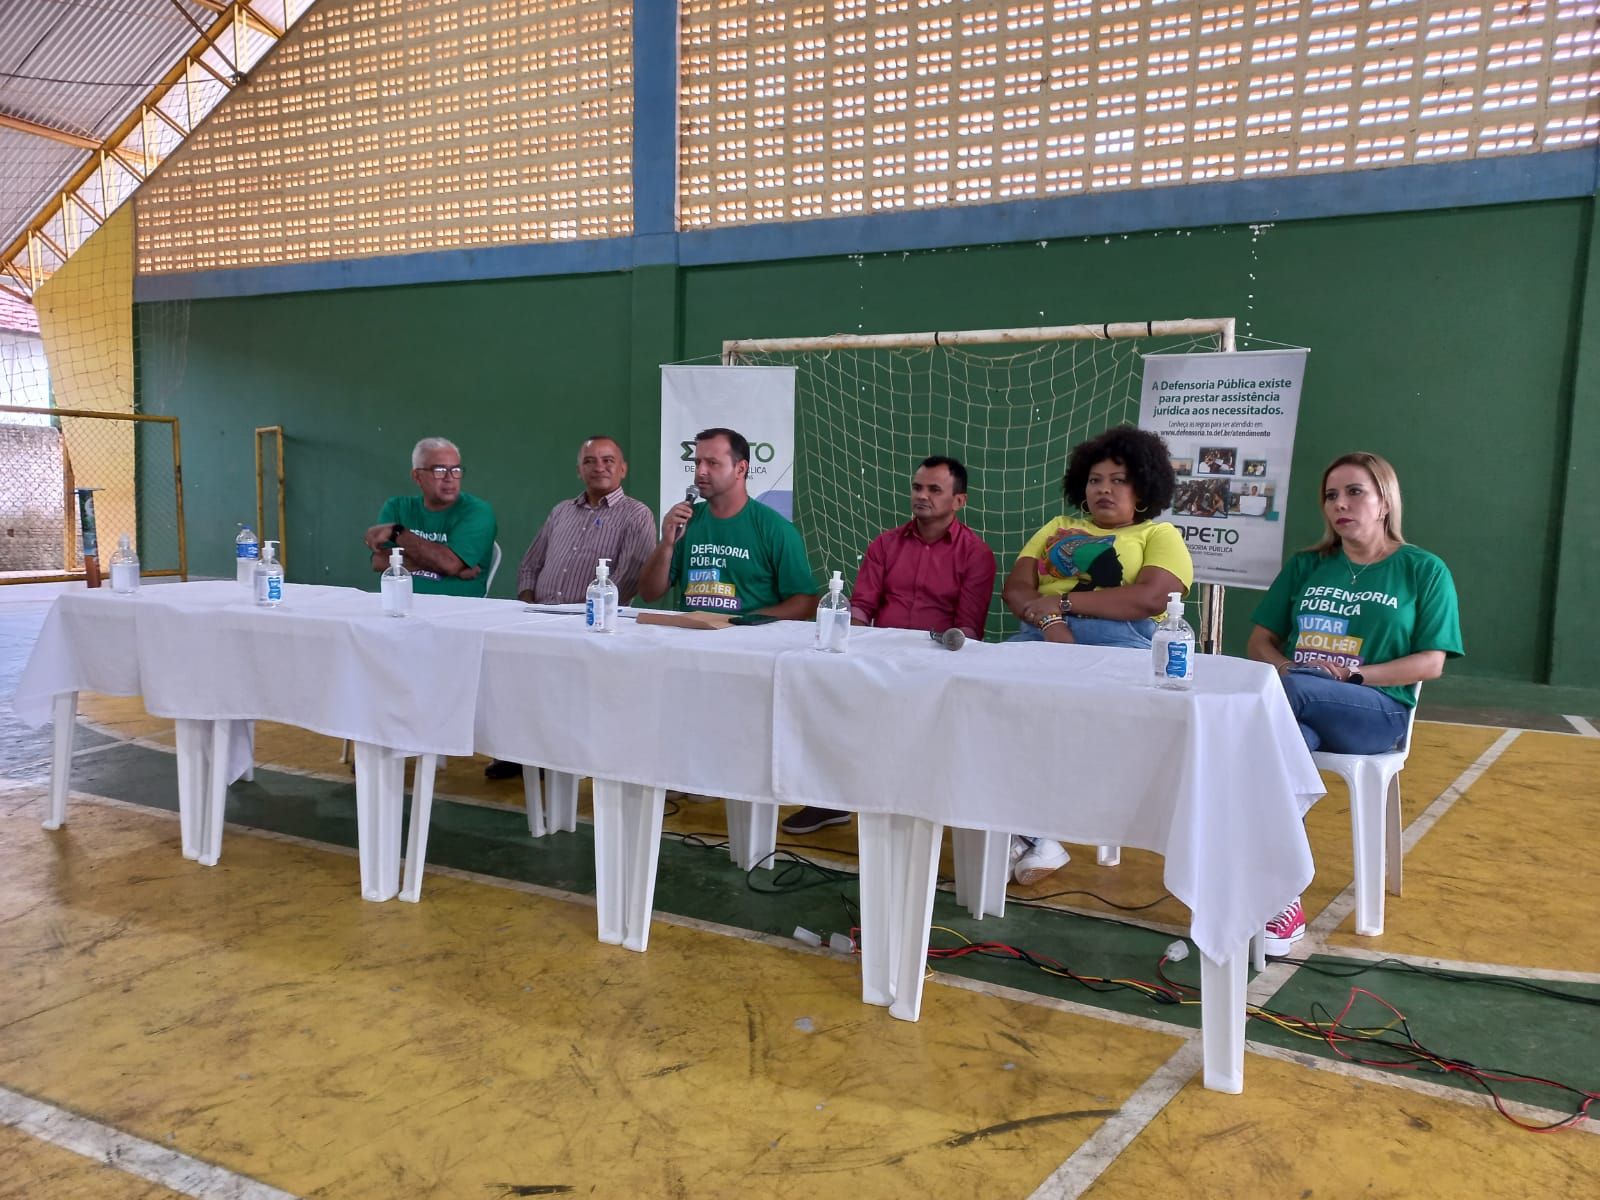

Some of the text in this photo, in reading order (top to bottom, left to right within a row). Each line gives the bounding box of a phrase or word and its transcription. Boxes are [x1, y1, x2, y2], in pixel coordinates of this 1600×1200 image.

[1152, 378, 1292, 391] A Defensoria Pública existe
[1159, 391, 1280, 405] para prestar assistência
[1153, 404, 1284, 418] jurídica aos necessitados.
[691, 543, 750, 560] DEFENSORIA
[690, 570, 717, 581] LUTAR
[689, 583, 732, 595] ACOLHER
[685, 596, 737, 609] DEFENDER
[1304, 586, 1398, 609] DEFENSORIA
[1300, 597, 1361, 616] PÚBLICA
[1296, 633, 1357, 652] ACOLHER
